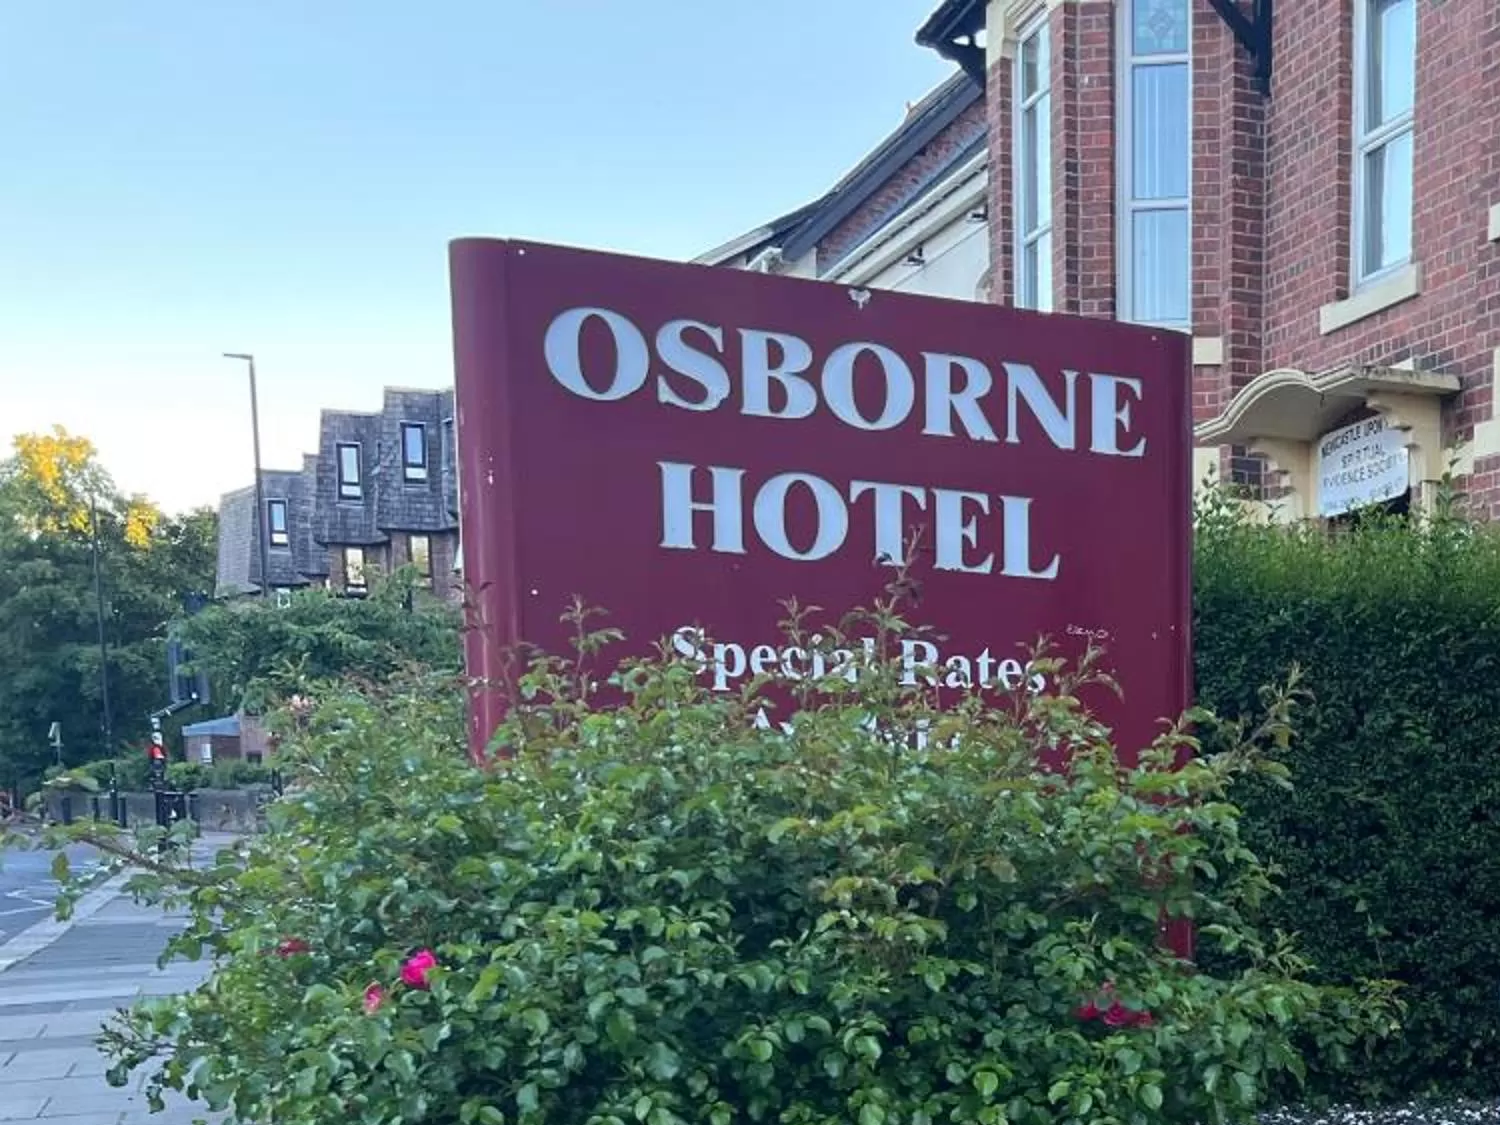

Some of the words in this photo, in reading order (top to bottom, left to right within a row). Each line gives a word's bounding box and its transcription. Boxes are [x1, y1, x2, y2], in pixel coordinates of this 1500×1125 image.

[543, 306, 1147, 458] OSBORNE
[658, 460, 1061, 582] HOTEL
[898, 638, 1046, 695] Rates
